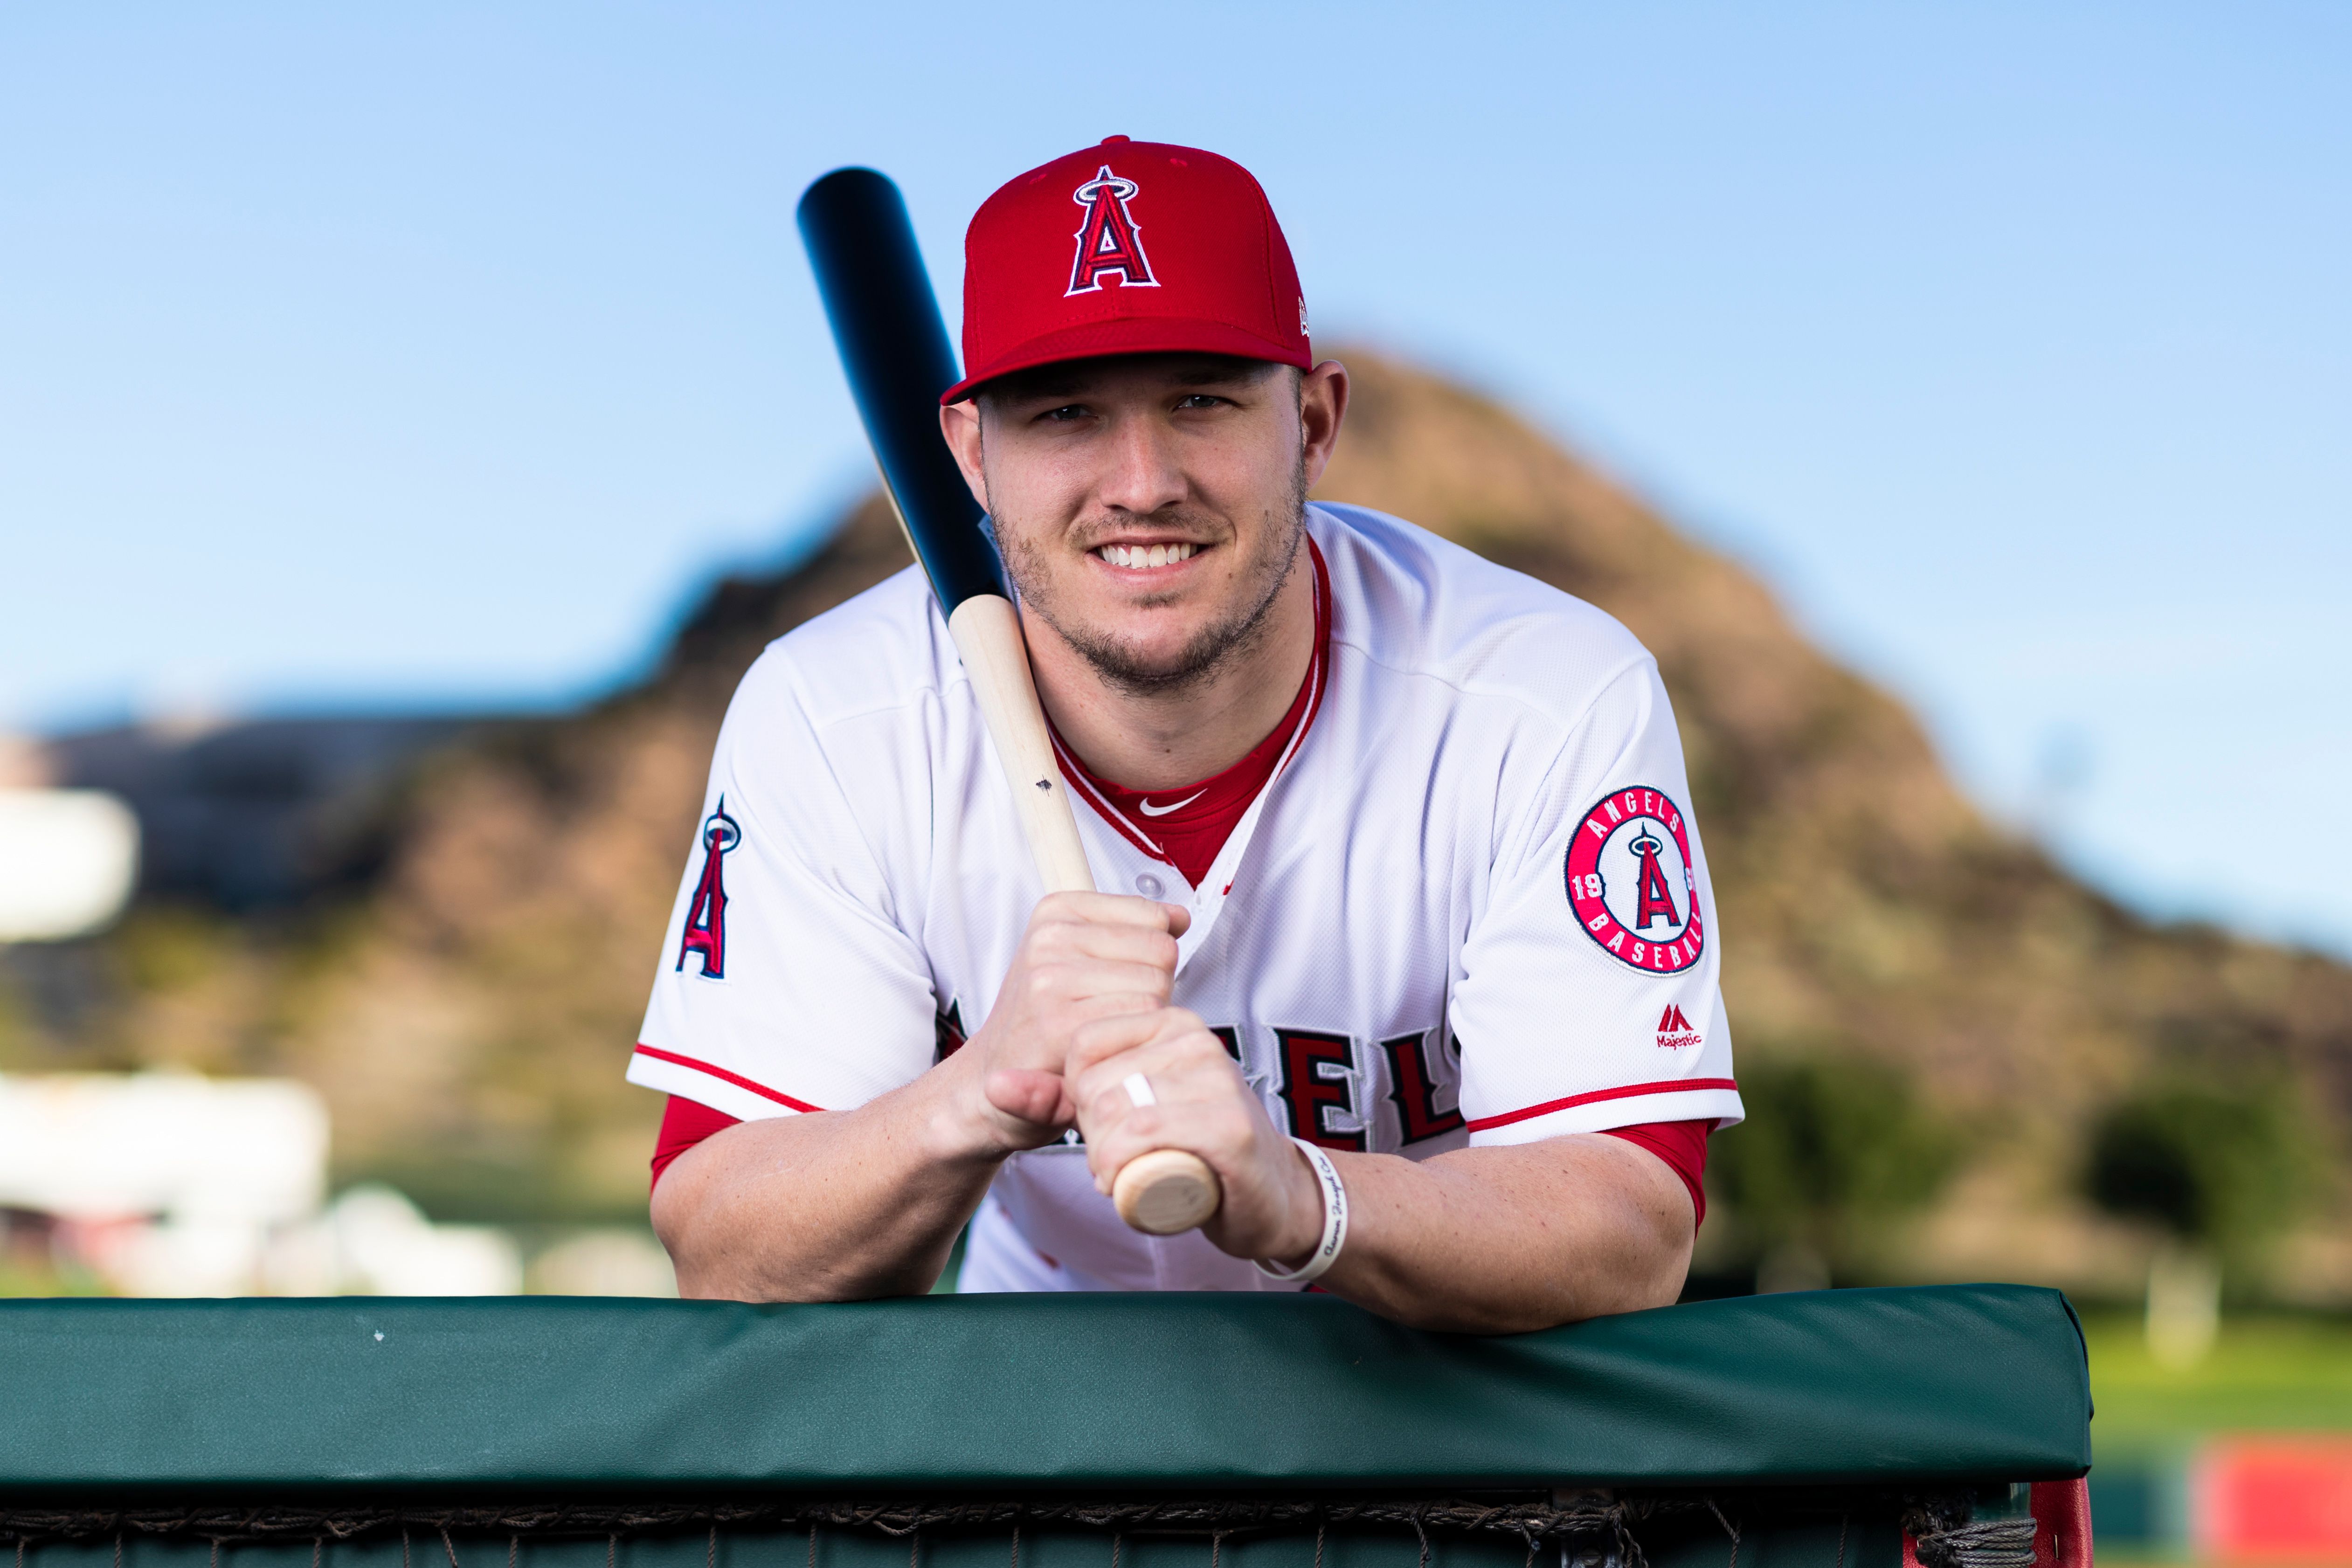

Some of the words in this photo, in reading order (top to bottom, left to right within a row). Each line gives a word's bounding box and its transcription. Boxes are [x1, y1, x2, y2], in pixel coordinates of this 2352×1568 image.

[1064, 165, 1161, 297] A
[1586, 791, 1680, 839] ANGELS
[676, 791, 740, 980] A
[1572, 873, 1603, 900] 19
[1629, 822, 1682, 930] A
[1588, 912, 1702, 968] BASEBALL
[1656, 1032, 1702, 1051] Majestic
